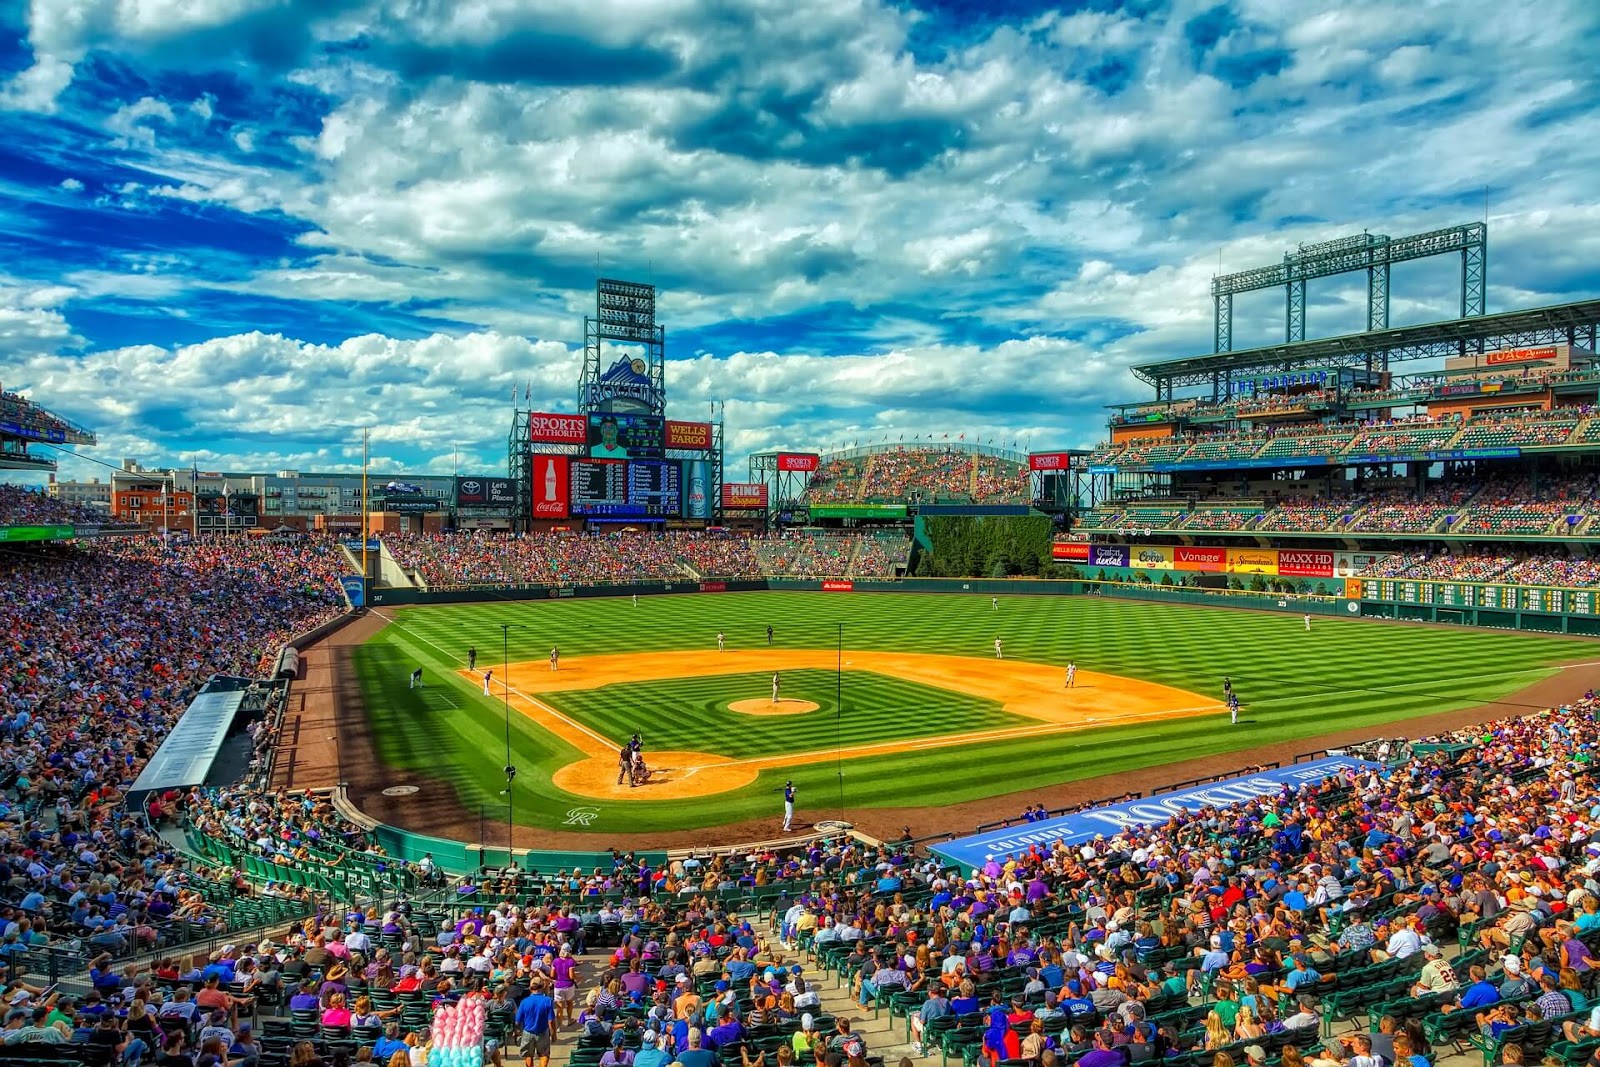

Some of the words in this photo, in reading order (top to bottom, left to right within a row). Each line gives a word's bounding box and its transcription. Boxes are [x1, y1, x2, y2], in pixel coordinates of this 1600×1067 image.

[1489, 349, 1534, 362] TUACA
[1263, 371, 1328, 389] ROOFTOP
[532, 417, 585, 431] SPORTS
[532, 429, 585, 438] AUTHORITY
[670, 425, 706, 436] WELLS
[671, 434, 706, 445] FARGO
[786, 457, 812, 465] SPORTS
[1035, 456, 1060, 464] SPORTS
[491, 481, 508, 489] Let's
[731, 485, 760, 496] KING
[1095, 553, 1123, 566] dental
[1180, 551, 1219, 562] Vonage
[1280, 553, 1313, 563] MAXX
[1315, 554, 1332, 564] HD
[1081, 777, 1297, 828] ROCKIES
[987, 827, 1074, 852] COLORADO
